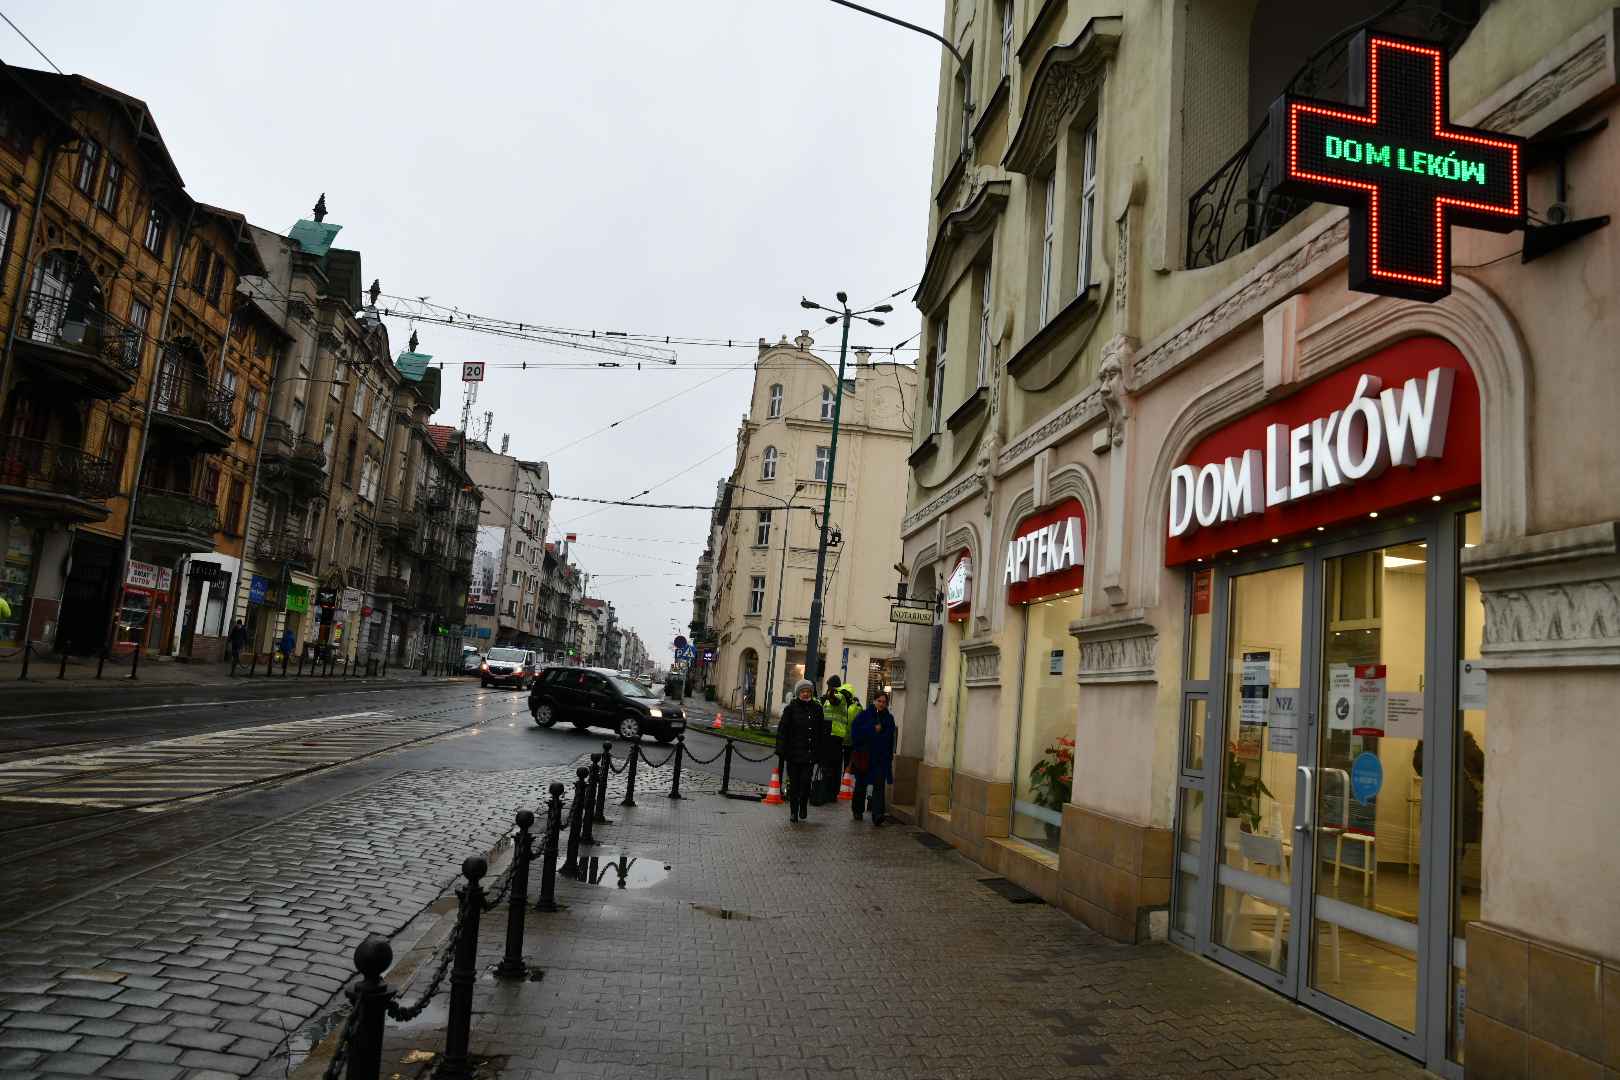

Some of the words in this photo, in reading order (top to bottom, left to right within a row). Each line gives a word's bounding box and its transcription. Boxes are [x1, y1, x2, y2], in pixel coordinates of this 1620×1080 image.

[1325, 135, 1391, 168] DOM
[1397, 150, 1486, 185] LEKÓW
[466, 366, 481, 377] 20
[1168, 448, 1265, 538] DOM
[1266, 366, 1456, 507] LEKÓW
[1003, 516, 1085, 586] APTEKA
[131, 561, 154, 572] FABRYKA
[893, 610, 932, 621] NOTARIUSZ
[1275, 696, 1293, 711] NFZ
